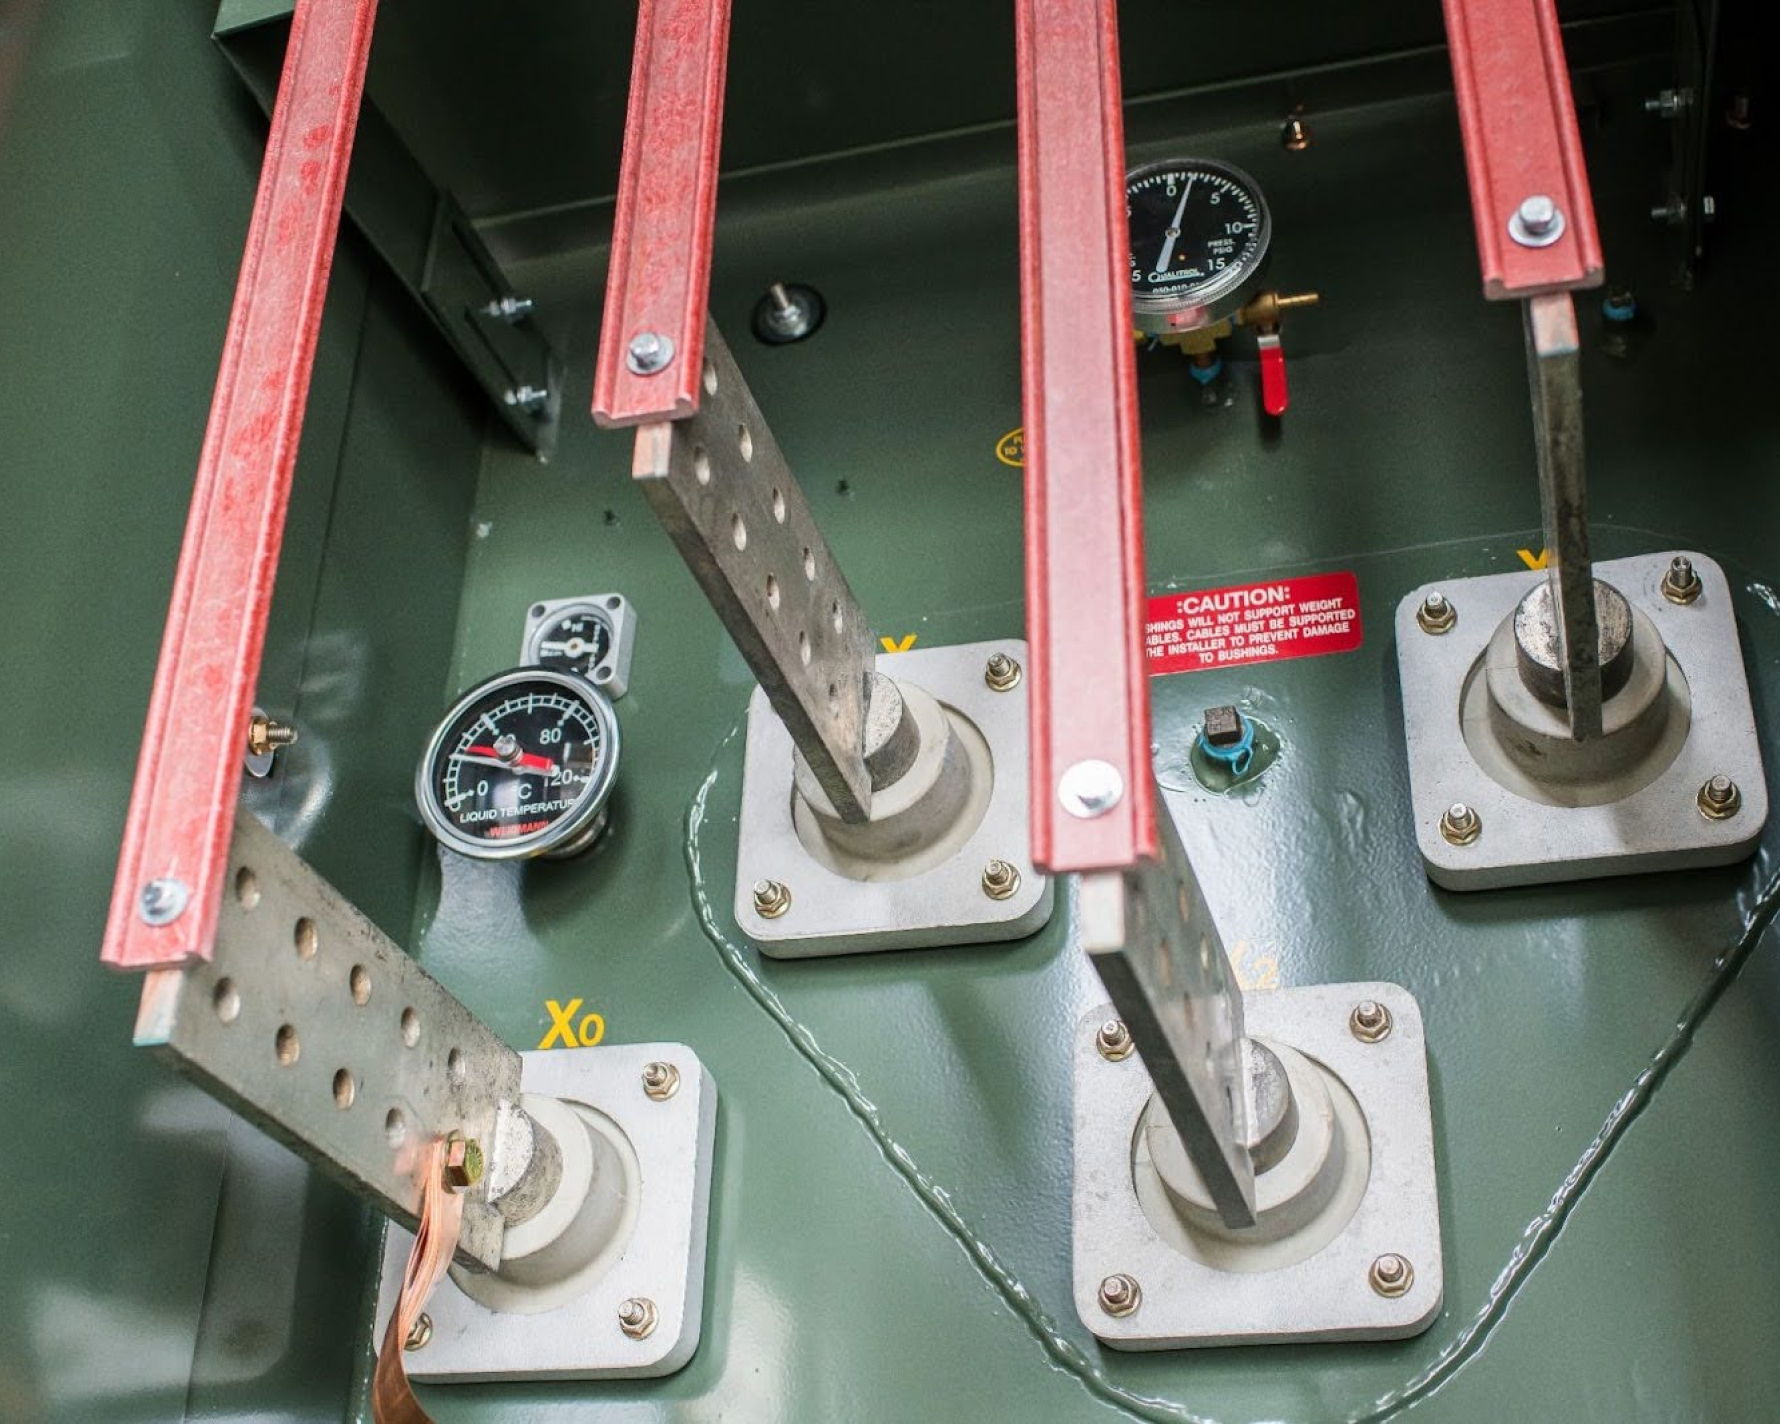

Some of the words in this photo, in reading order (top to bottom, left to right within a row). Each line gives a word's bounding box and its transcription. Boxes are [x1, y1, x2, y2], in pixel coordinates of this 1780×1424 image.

[1166, 185, 1177, 197] 0
[1210, 193, 1221, 205] 5
[1225, 221, 1243, 235] 10
[1207, 257, 1226, 271] 15
[1187, 615, 1214, 628] WILL
[1217, 611, 1241, 624] NOT
[1243, 604, 1296, 621] SUPPORT
[1298, 597, 1344, 613] WEIGHT
[1186, 624, 1231, 640] CABLES
[1233, 619, 1266, 635] MUST
[1268, 617, 1285, 630] BE
[1288, 608, 1357, 627] SUPPORTED
[1167, 638, 1226, 656] INSTALLER
[1229, 634, 1245, 648] TO
[1248, 627, 1300, 645] PREVENT
[1302, 620, 1351, 638] DAMAGE
[1199, 651, 1214, 664] TO
[1217, 643, 1280, 662] BUSHINGS.
[539, 727, 562, 745] 80
[476, 779, 489, 797] 0
[459, 809, 498, 824] LIQUID
